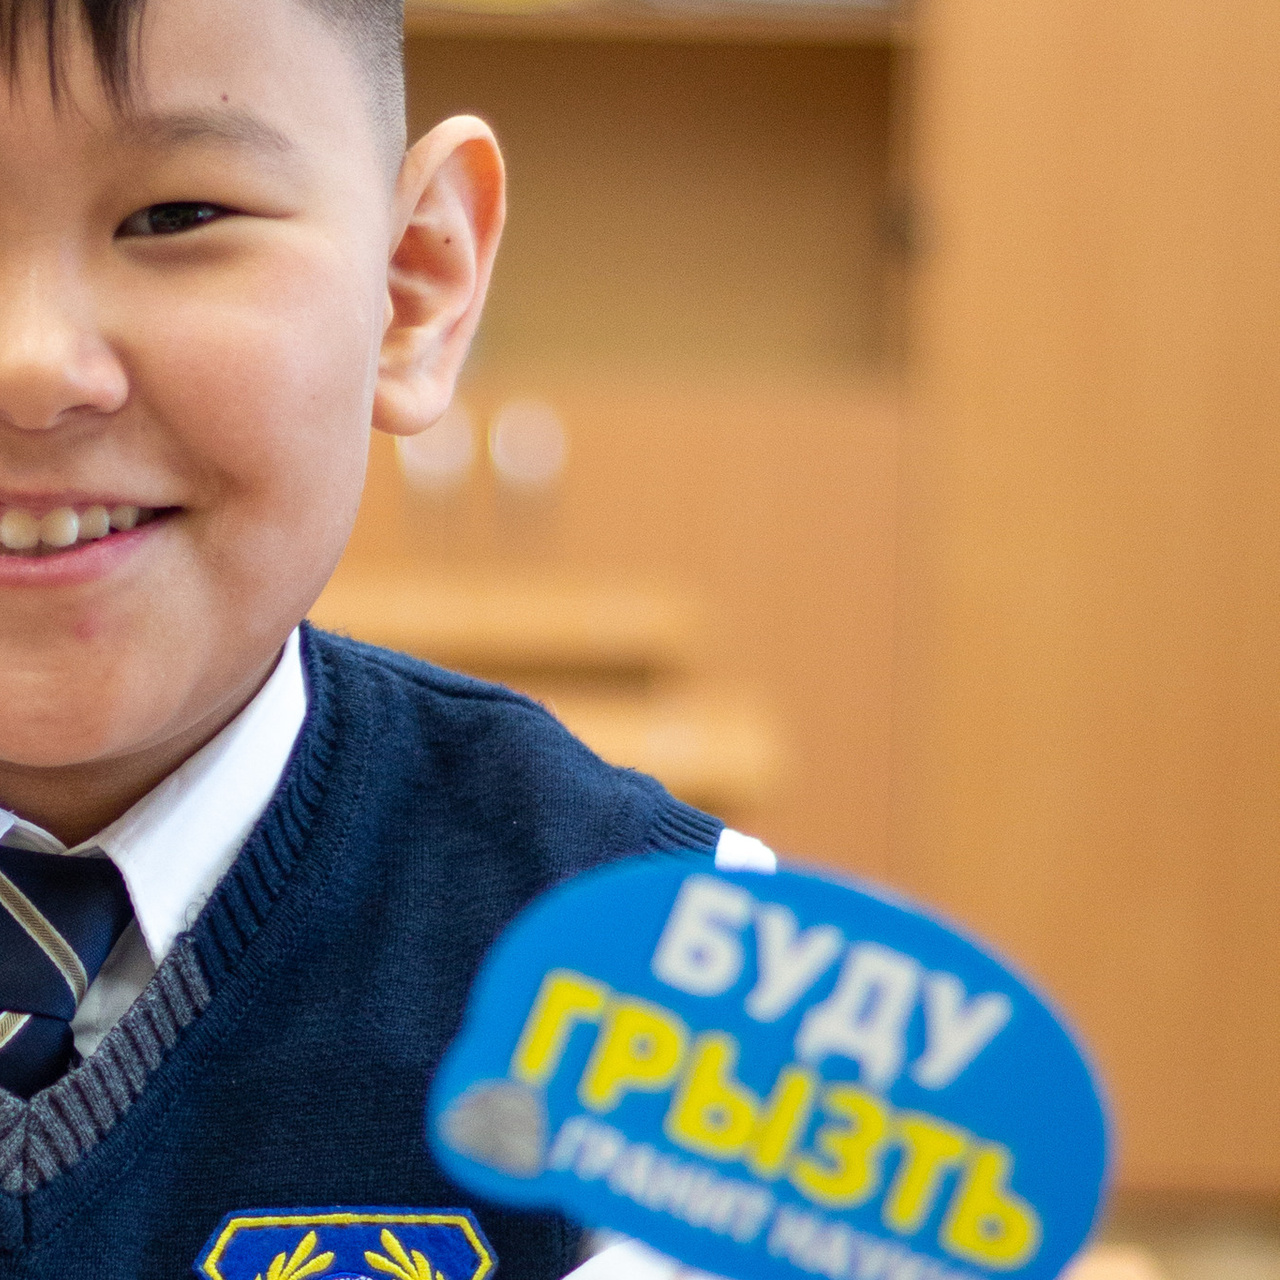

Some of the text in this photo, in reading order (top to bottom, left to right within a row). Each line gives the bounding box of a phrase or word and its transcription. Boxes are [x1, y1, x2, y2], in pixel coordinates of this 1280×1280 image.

[650, 873, 1014, 1090] БУДУ
[511, 968, 1042, 1269] ГРЫЗТЬ
[545, 1117, 775, 1243] ГРАНИТ
